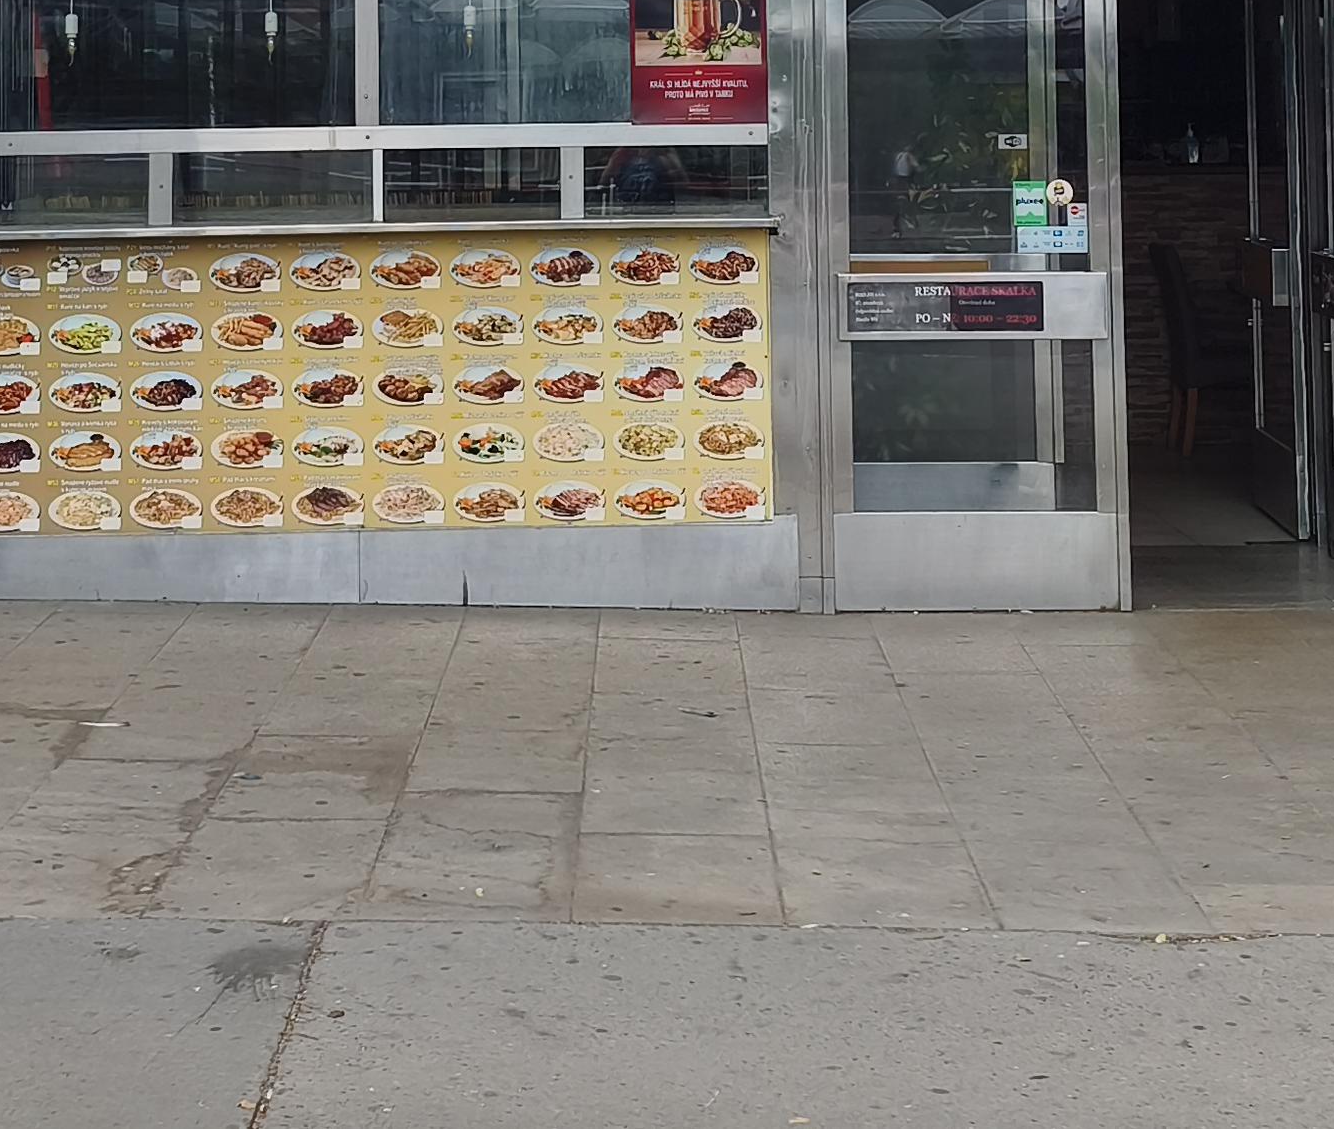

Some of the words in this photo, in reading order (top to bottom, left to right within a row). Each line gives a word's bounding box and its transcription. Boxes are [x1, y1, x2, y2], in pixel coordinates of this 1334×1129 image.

[914, 286, 990, 296] RESTAURACE
[991, 285, 1037, 296] SKALKA
[915, 313, 931, 324] PO
